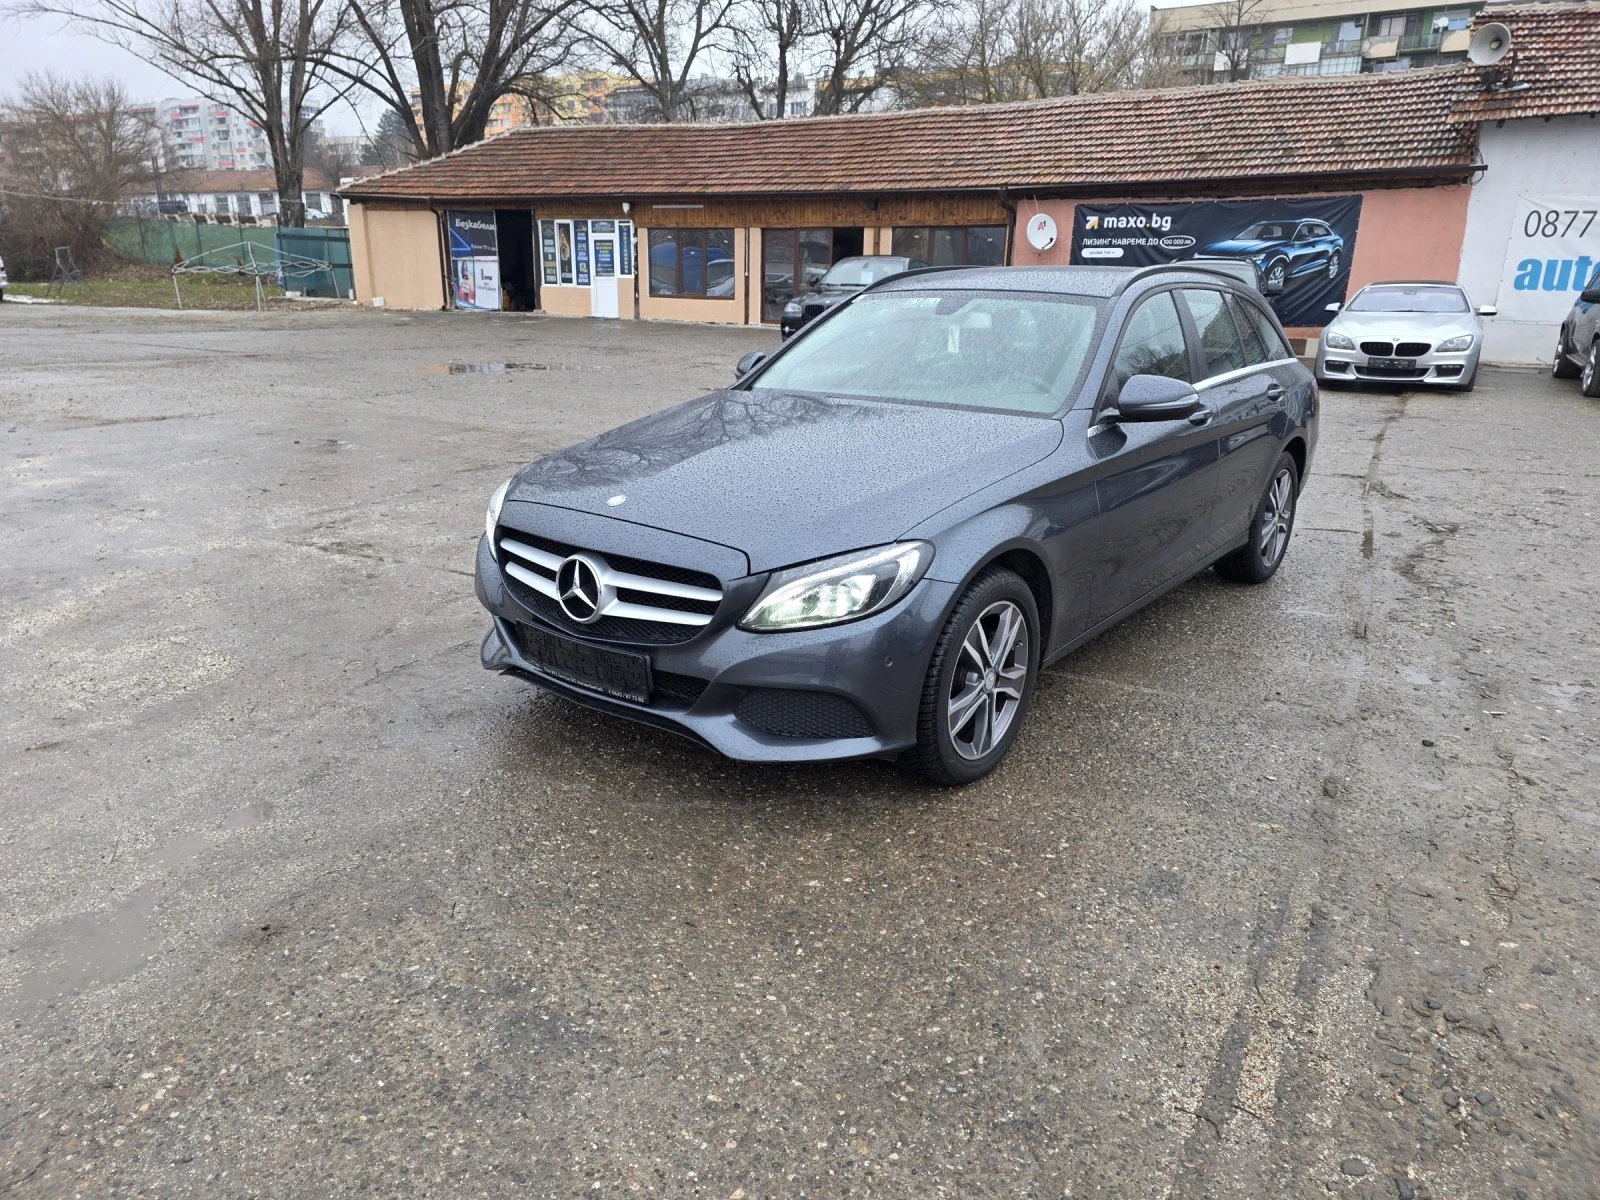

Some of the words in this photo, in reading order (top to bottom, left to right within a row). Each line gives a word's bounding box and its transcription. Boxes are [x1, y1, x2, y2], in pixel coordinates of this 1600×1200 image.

[1037, 220, 1047, 231] A1
[1103, 212, 1172, 231] maxo.bg
[1524, 209, 1598, 239] 0877
[1082, 238, 1111, 246] ЛИЗИНГ
[1112, 237, 1147, 246] НАВРЕМЕ
[1147, 237, 1159, 247] ДО
